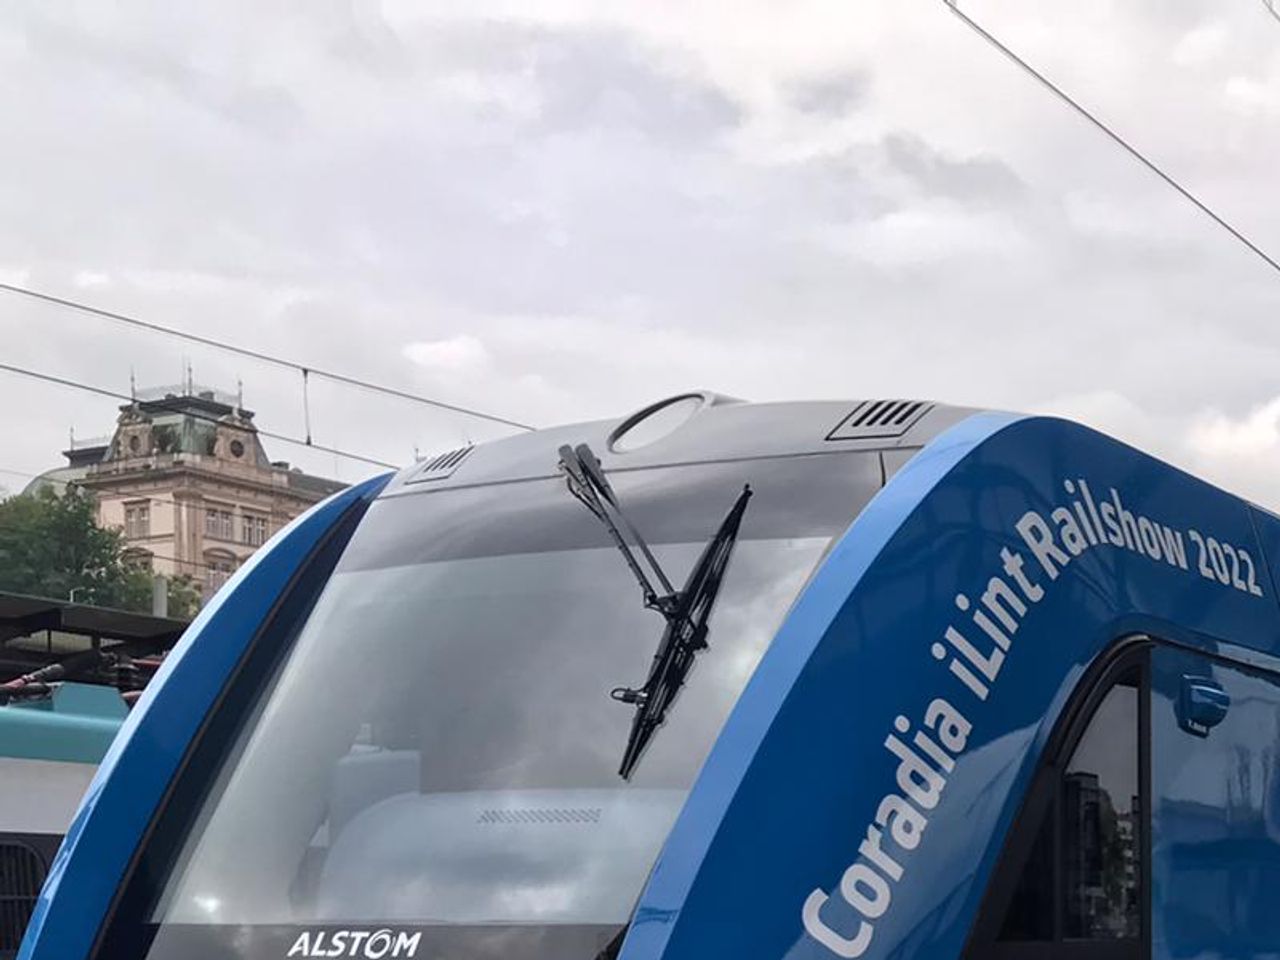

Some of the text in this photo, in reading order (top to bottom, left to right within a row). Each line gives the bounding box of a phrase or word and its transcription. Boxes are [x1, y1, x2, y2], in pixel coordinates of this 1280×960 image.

[802, 480, 1263, 959] Coradia iLint Railshow 2022
[287, 928, 422, 959] ALSTOM
